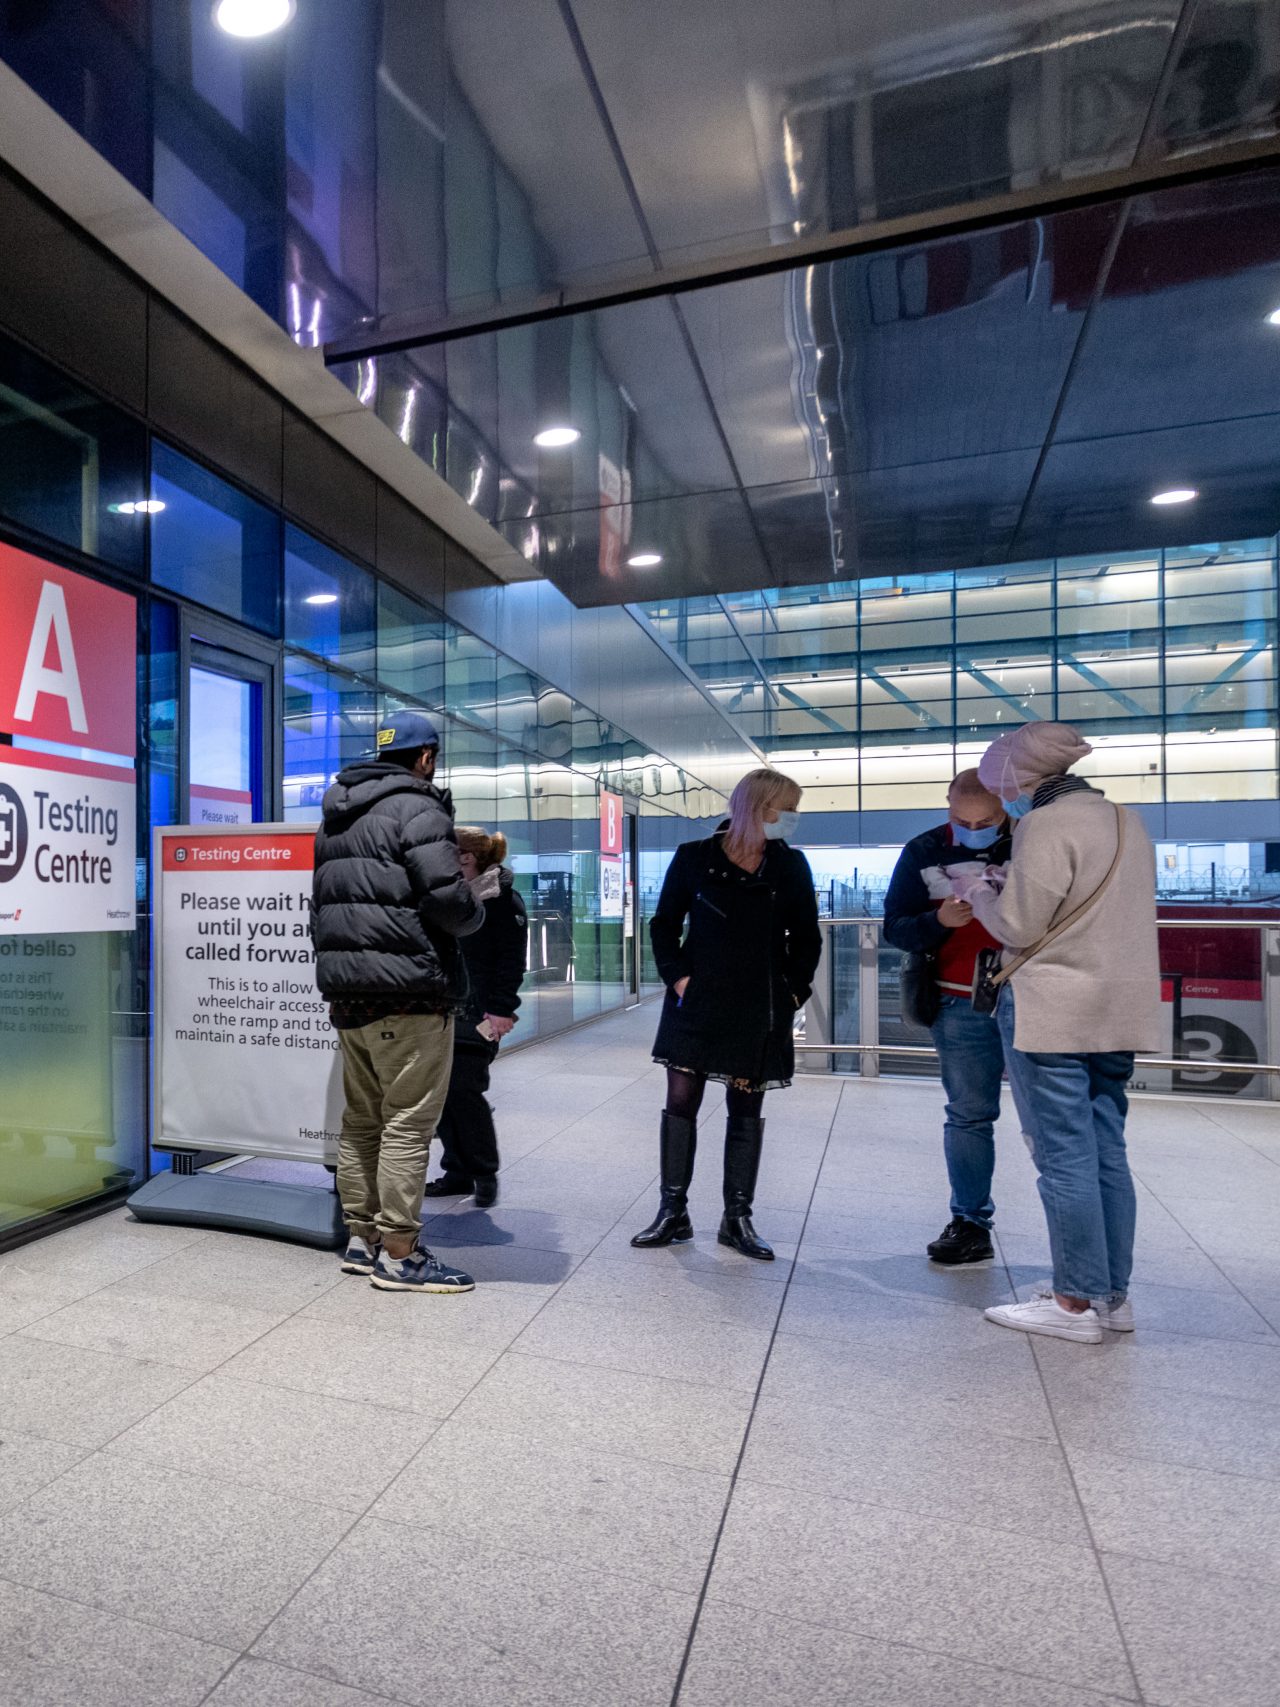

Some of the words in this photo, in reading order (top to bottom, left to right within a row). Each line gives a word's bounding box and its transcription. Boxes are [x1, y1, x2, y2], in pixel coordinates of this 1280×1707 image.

[13, 580, 88, 734] A
[34, 790, 118, 846] Testing
[202, 809, 223, 823] Please
[224, 813, 239, 824] wait
[608, 798, 616, 848] B
[35, 844, 112, 884] Centre
[191, 847, 240, 863] Testing
[243, 847, 291, 860] Centre
[181, 892, 240, 910] Please
[246, 892, 293, 911] wait
[198, 917, 241, 936] until
[247, 922, 286, 941] you
[185, 942, 241, 961] called
[208, 977, 235, 991] This
[239, 978, 249, 992] is
[253, 980, 268, 993] to
[272, 980, 313, 995] allow
[1184, 985, 1219, 994] Centre
[198, 995, 275, 1010] wheelchair
[279, 1000, 325, 1013] access
[192, 1013, 210, 1025] on
[214, 1012, 236, 1026] the
[240, 1016, 278, 1031] ramp
[282, 1017, 311, 1031] and
[315, 1019, 332, 1032] to
[175, 1028, 235, 1044] maintain
[238, 1034, 247, 1045] a
[251, 1033, 280, 1047] safe
[1180, 1030, 1223, 1082] 3
[299, 1127, 341, 1141] Heathro
